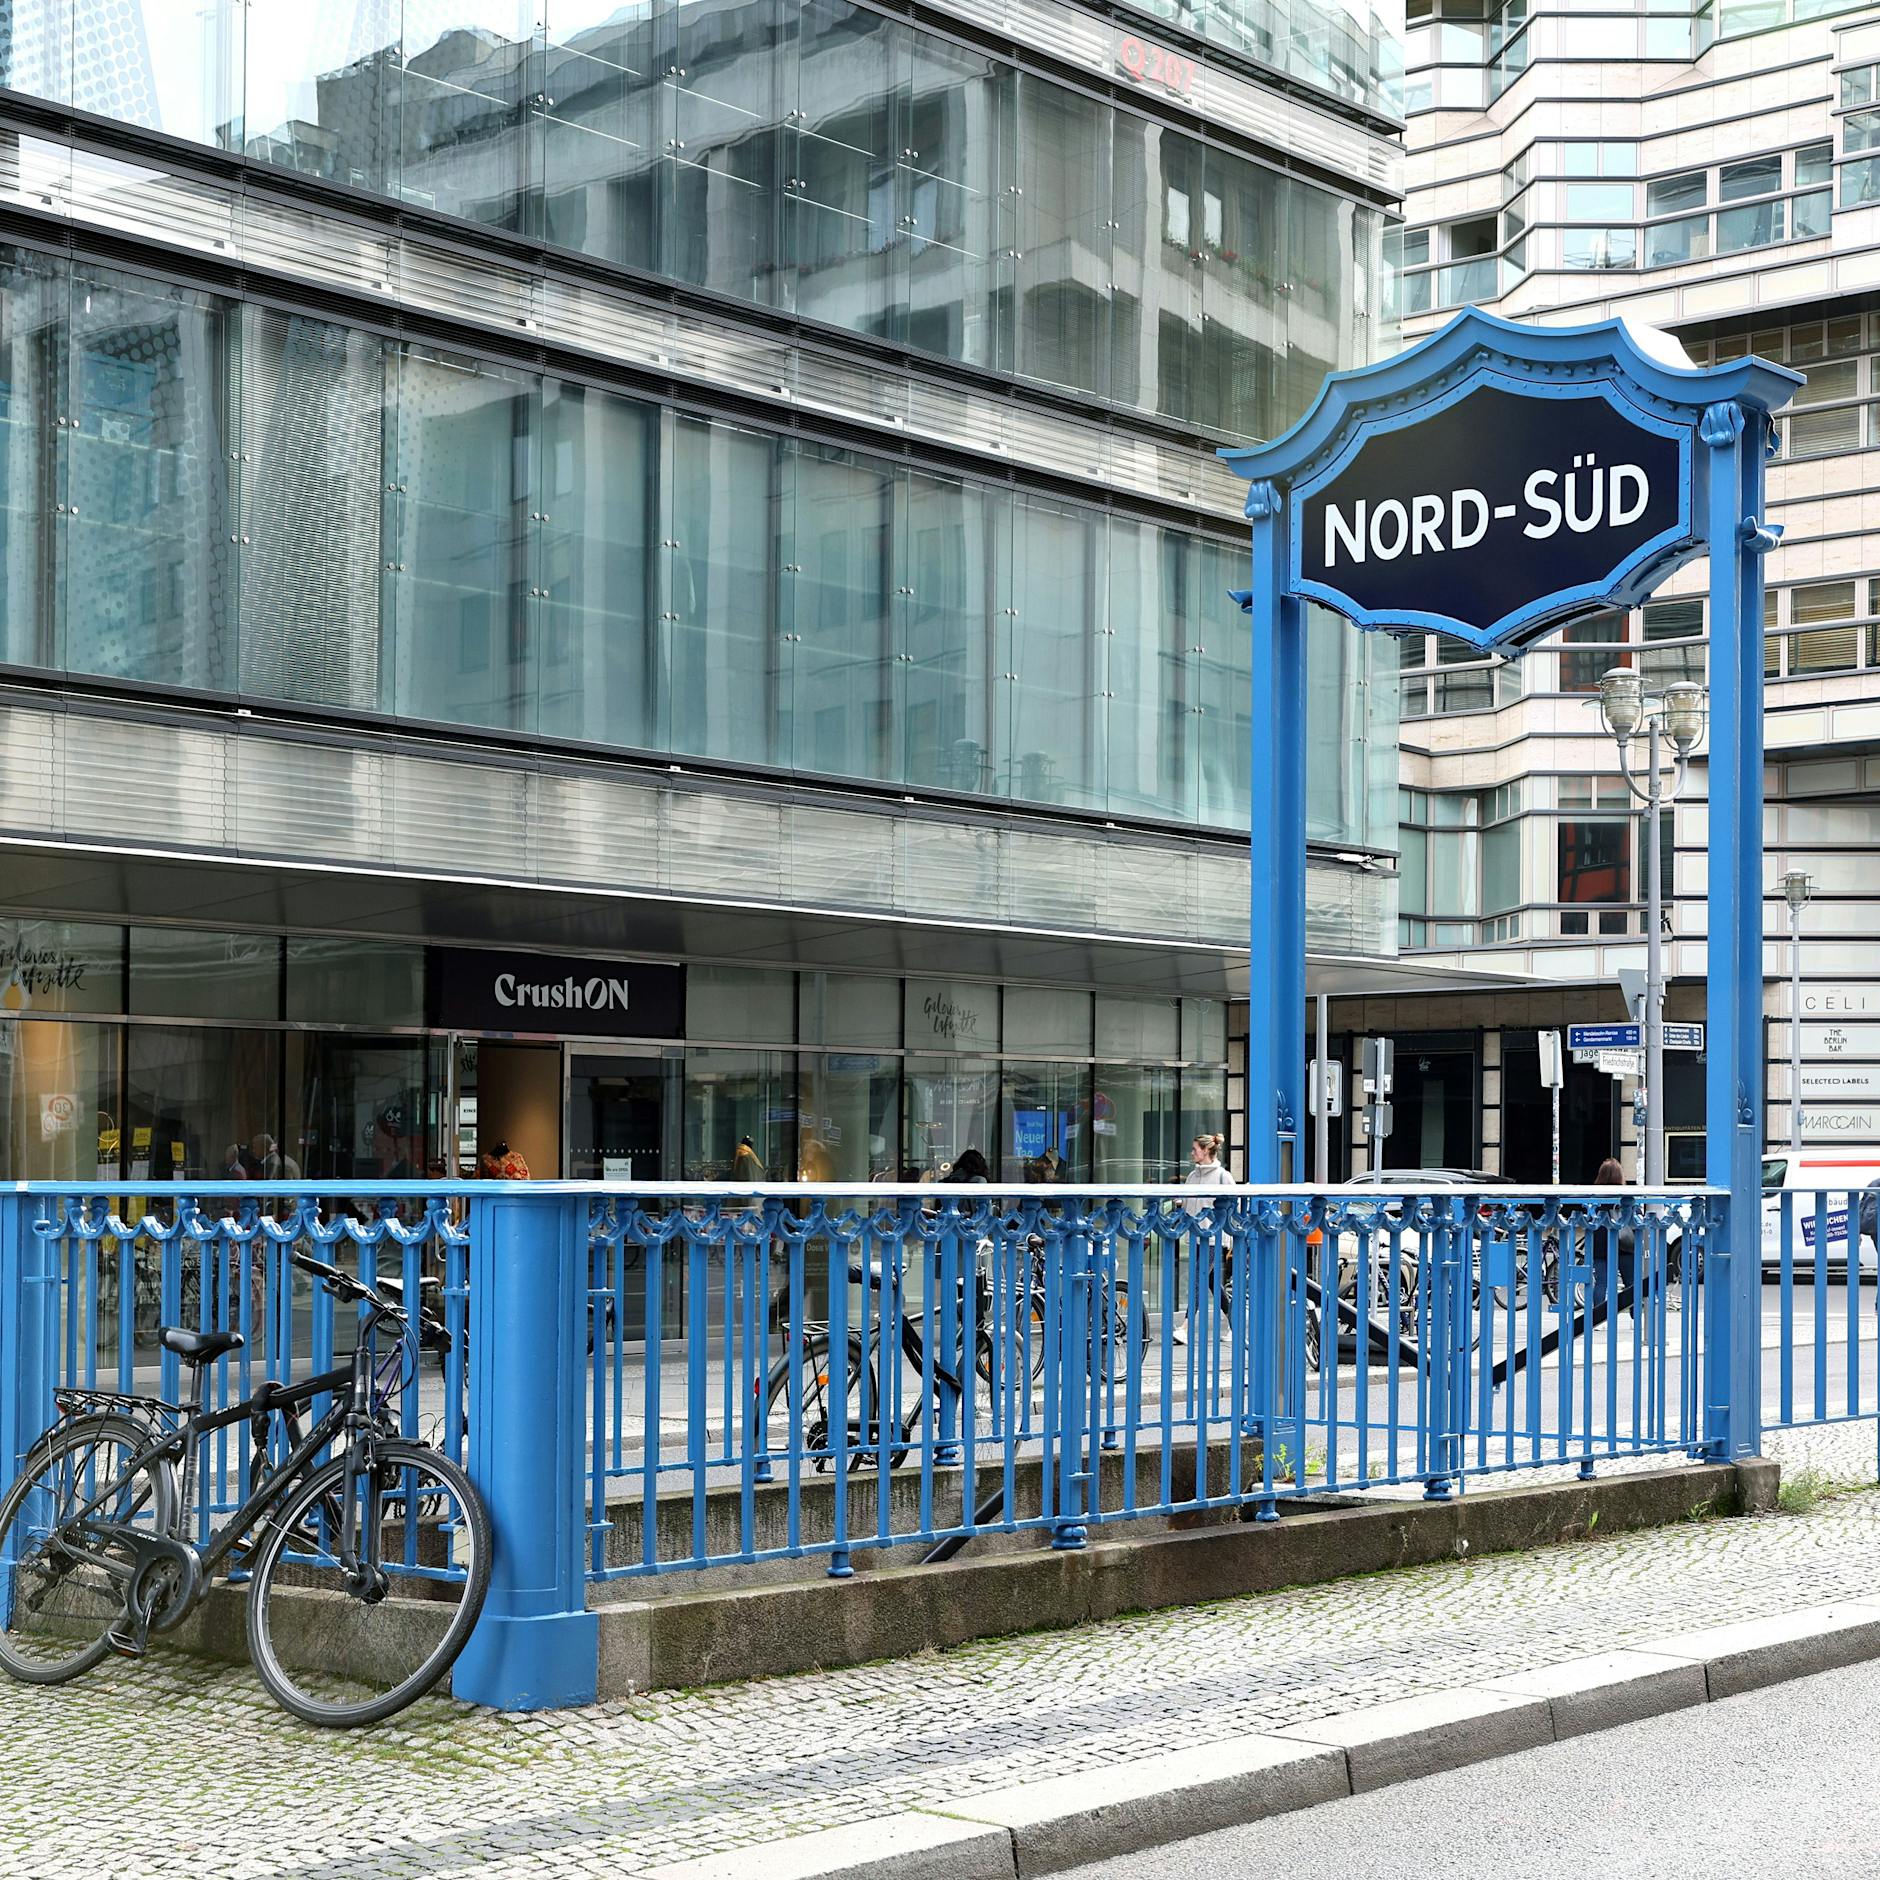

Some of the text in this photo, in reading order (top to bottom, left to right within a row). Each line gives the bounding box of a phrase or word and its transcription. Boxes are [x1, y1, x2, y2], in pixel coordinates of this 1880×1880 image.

[1325, 453, 1650, 568] NORD-SÜD
[494, 973, 630, 1011] CrushON
[1805, 996, 1865, 1010] CELI
[1824, 1037, 1848, 1045] BERLIN
[1015, 1130, 1046, 1143] Neuer
